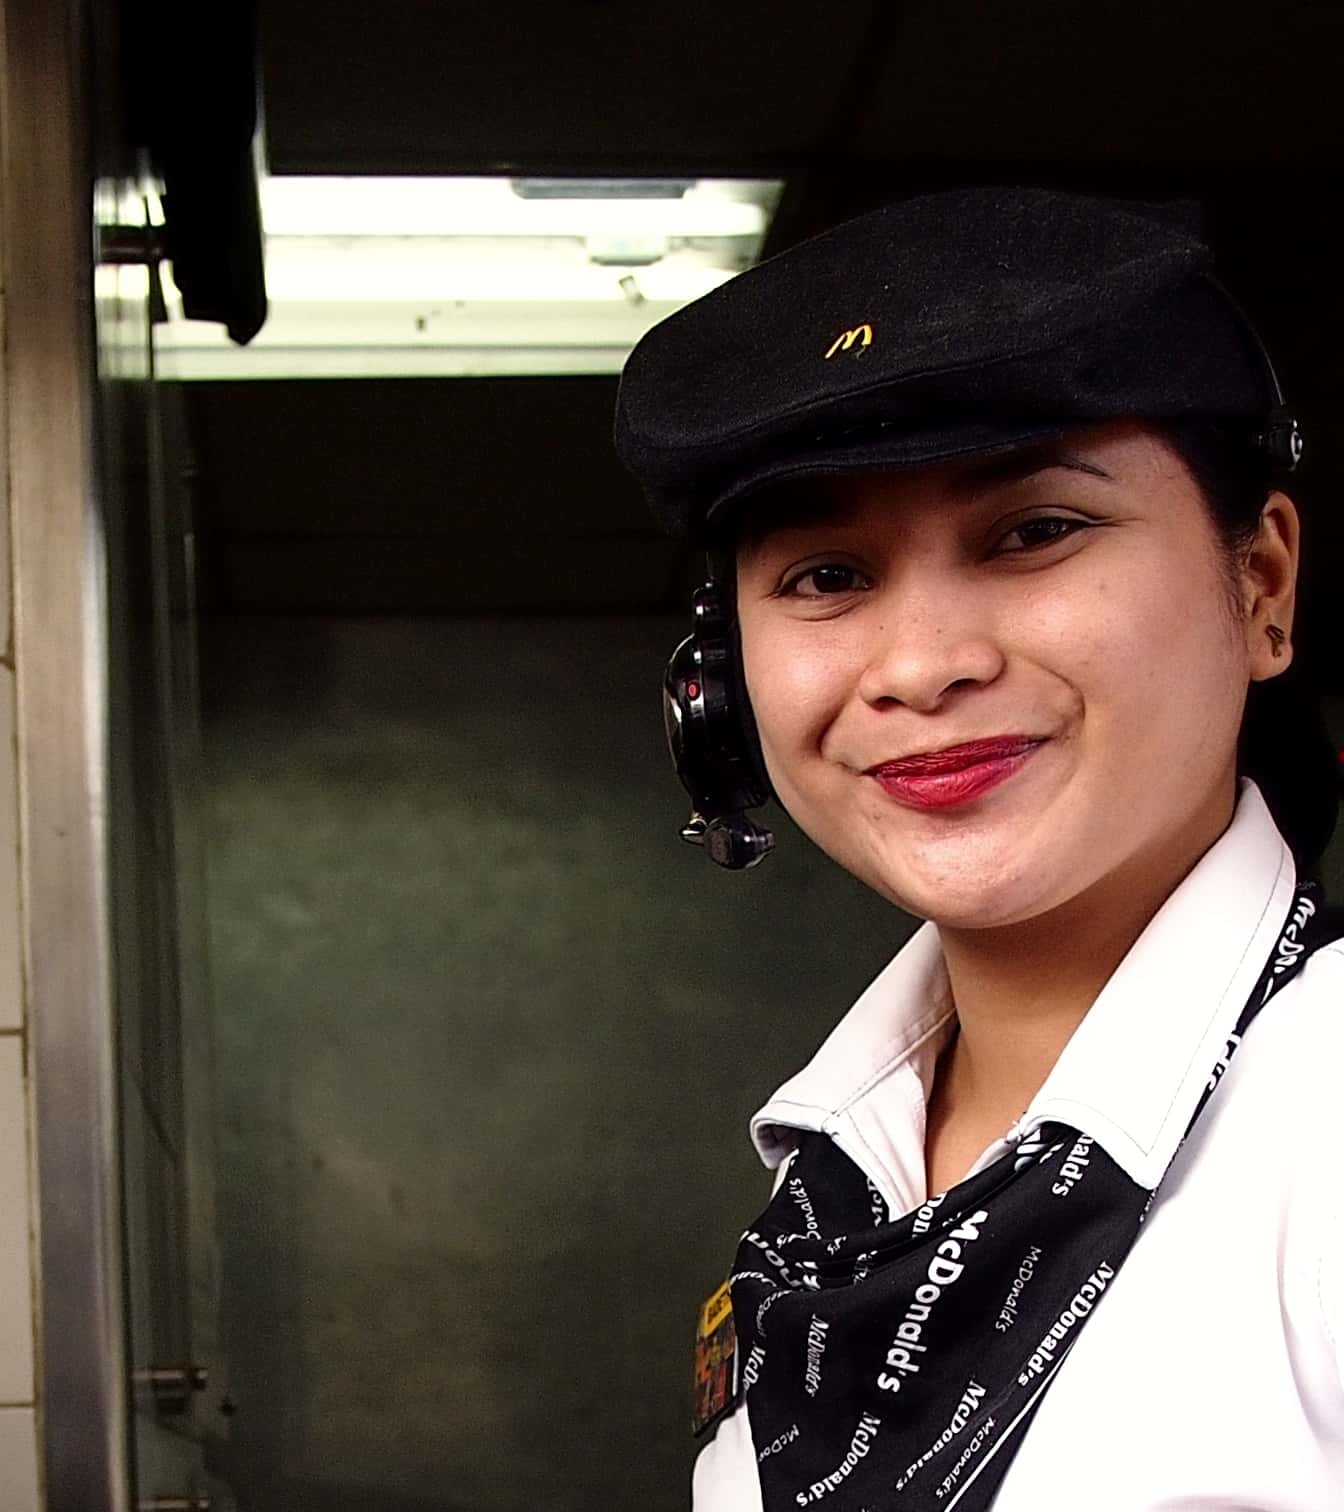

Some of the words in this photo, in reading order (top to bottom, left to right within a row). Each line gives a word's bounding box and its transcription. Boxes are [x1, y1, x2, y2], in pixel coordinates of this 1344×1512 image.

[877, 1210, 988, 1393] McDonald's
[995, 1246, 1042, 1333] McDonald's
[1018, 1261, 1114, 1386] McDonald's
[795, 1410, 882, 1507] McDonald's
[895, 1380, 987, 1491] McDonald's
[935, 1416, 996, 1499] McDonald's
